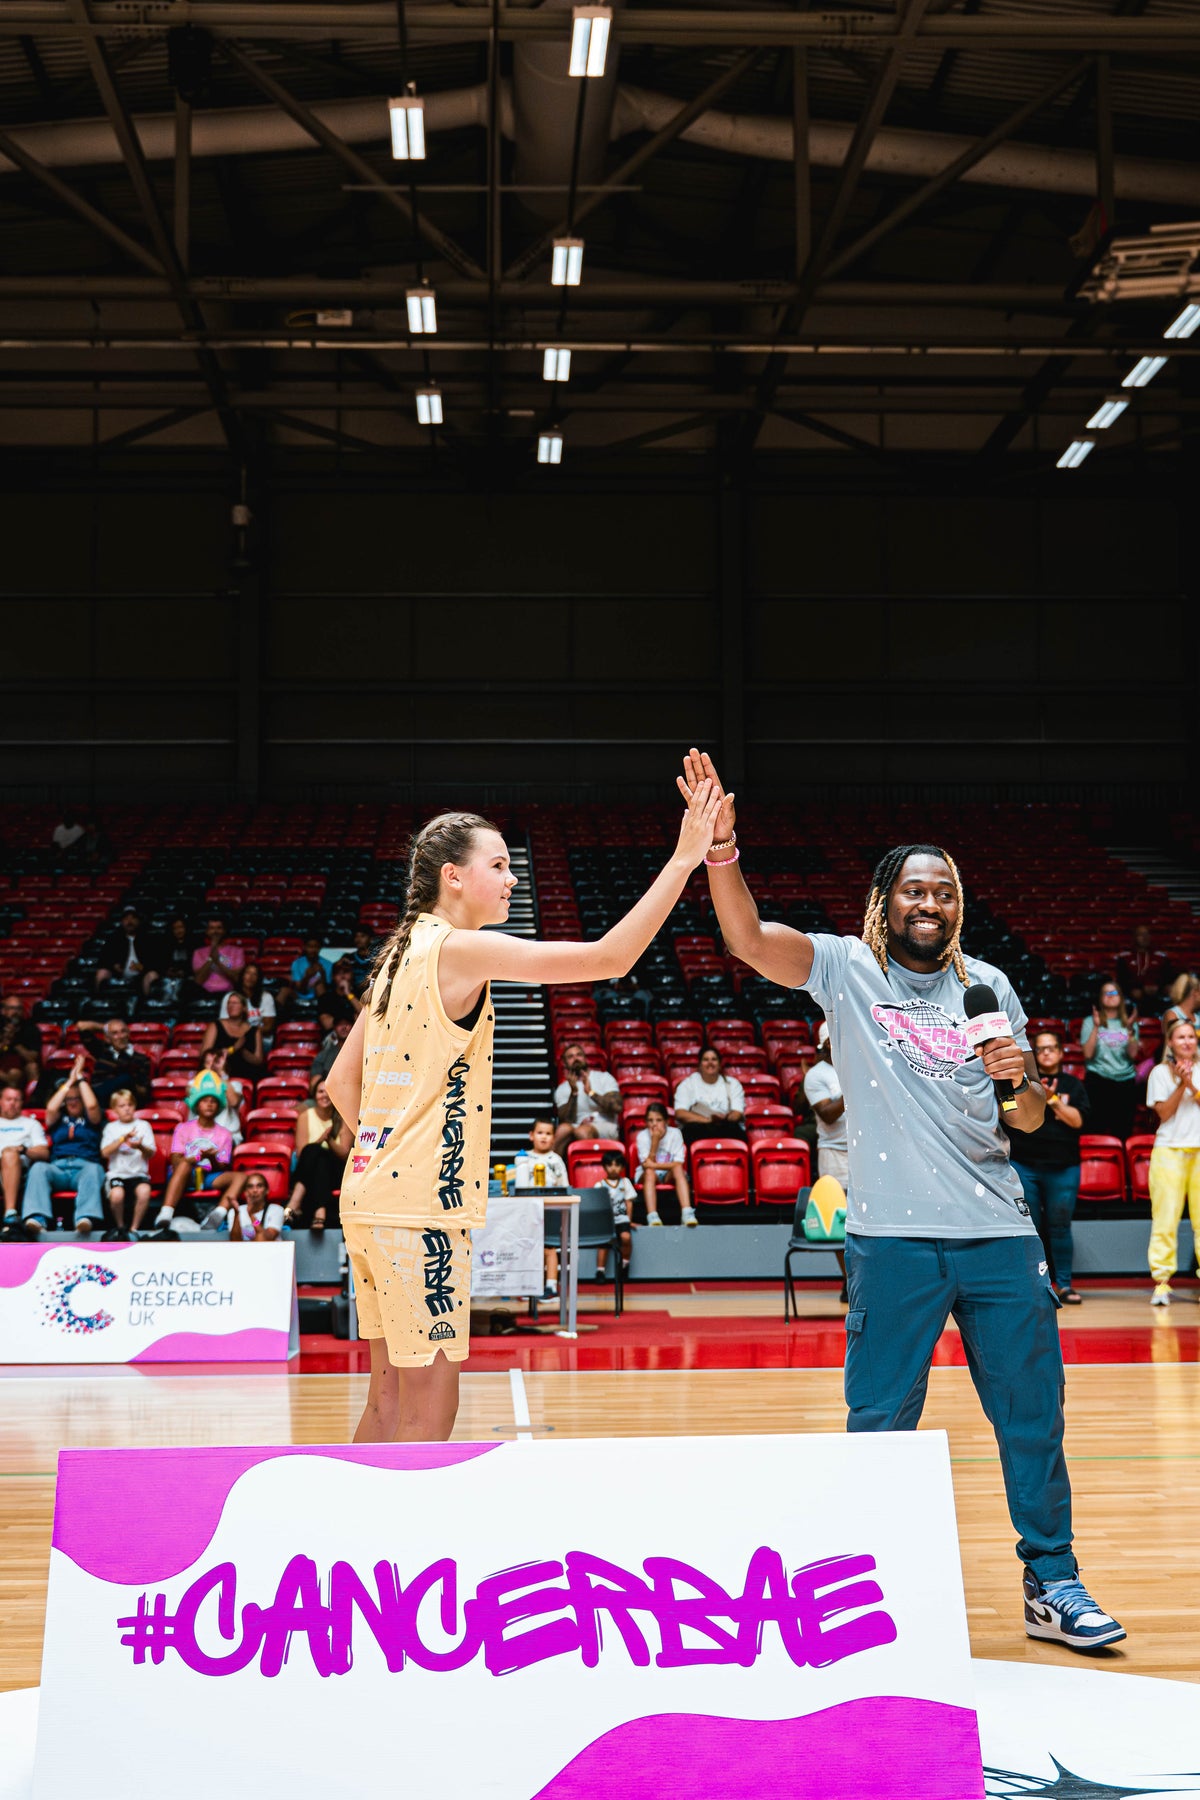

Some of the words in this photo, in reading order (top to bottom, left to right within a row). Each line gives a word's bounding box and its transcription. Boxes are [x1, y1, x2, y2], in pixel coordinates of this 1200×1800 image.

[909, 1063, 937, 1078] SINCE
[131, 1271, 214, 1287] CANCER
[130, 1291, 233, 1306] RESEARCH
[128, 1310, 155, 1326] UK
[117, 1546, 897, 1677] #CANCERBAE
